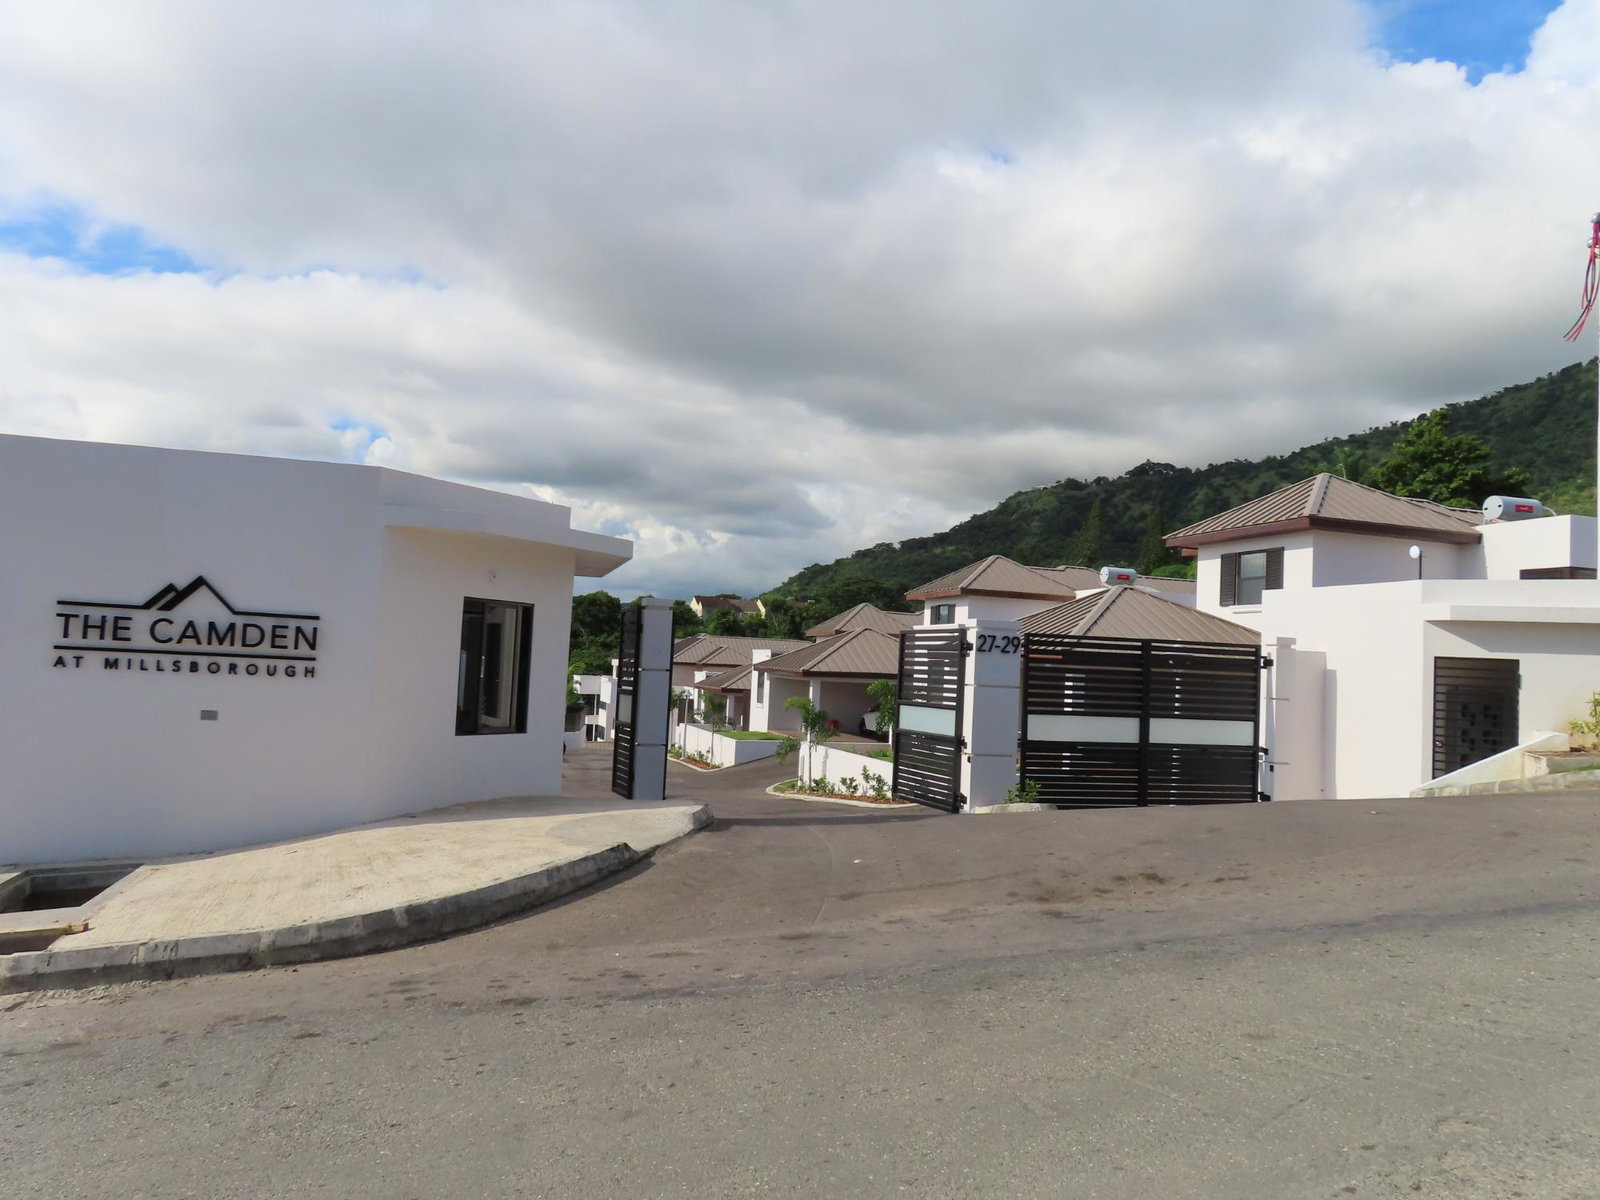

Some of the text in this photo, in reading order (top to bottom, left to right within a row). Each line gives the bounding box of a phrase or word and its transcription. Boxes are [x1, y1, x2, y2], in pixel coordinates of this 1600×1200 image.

[56, 613, 318, 650] THE CAMDEN
[977, 634, 1021, 654] 27-29
[53, 655, 315, 678] AT MILLSBOROUGH
